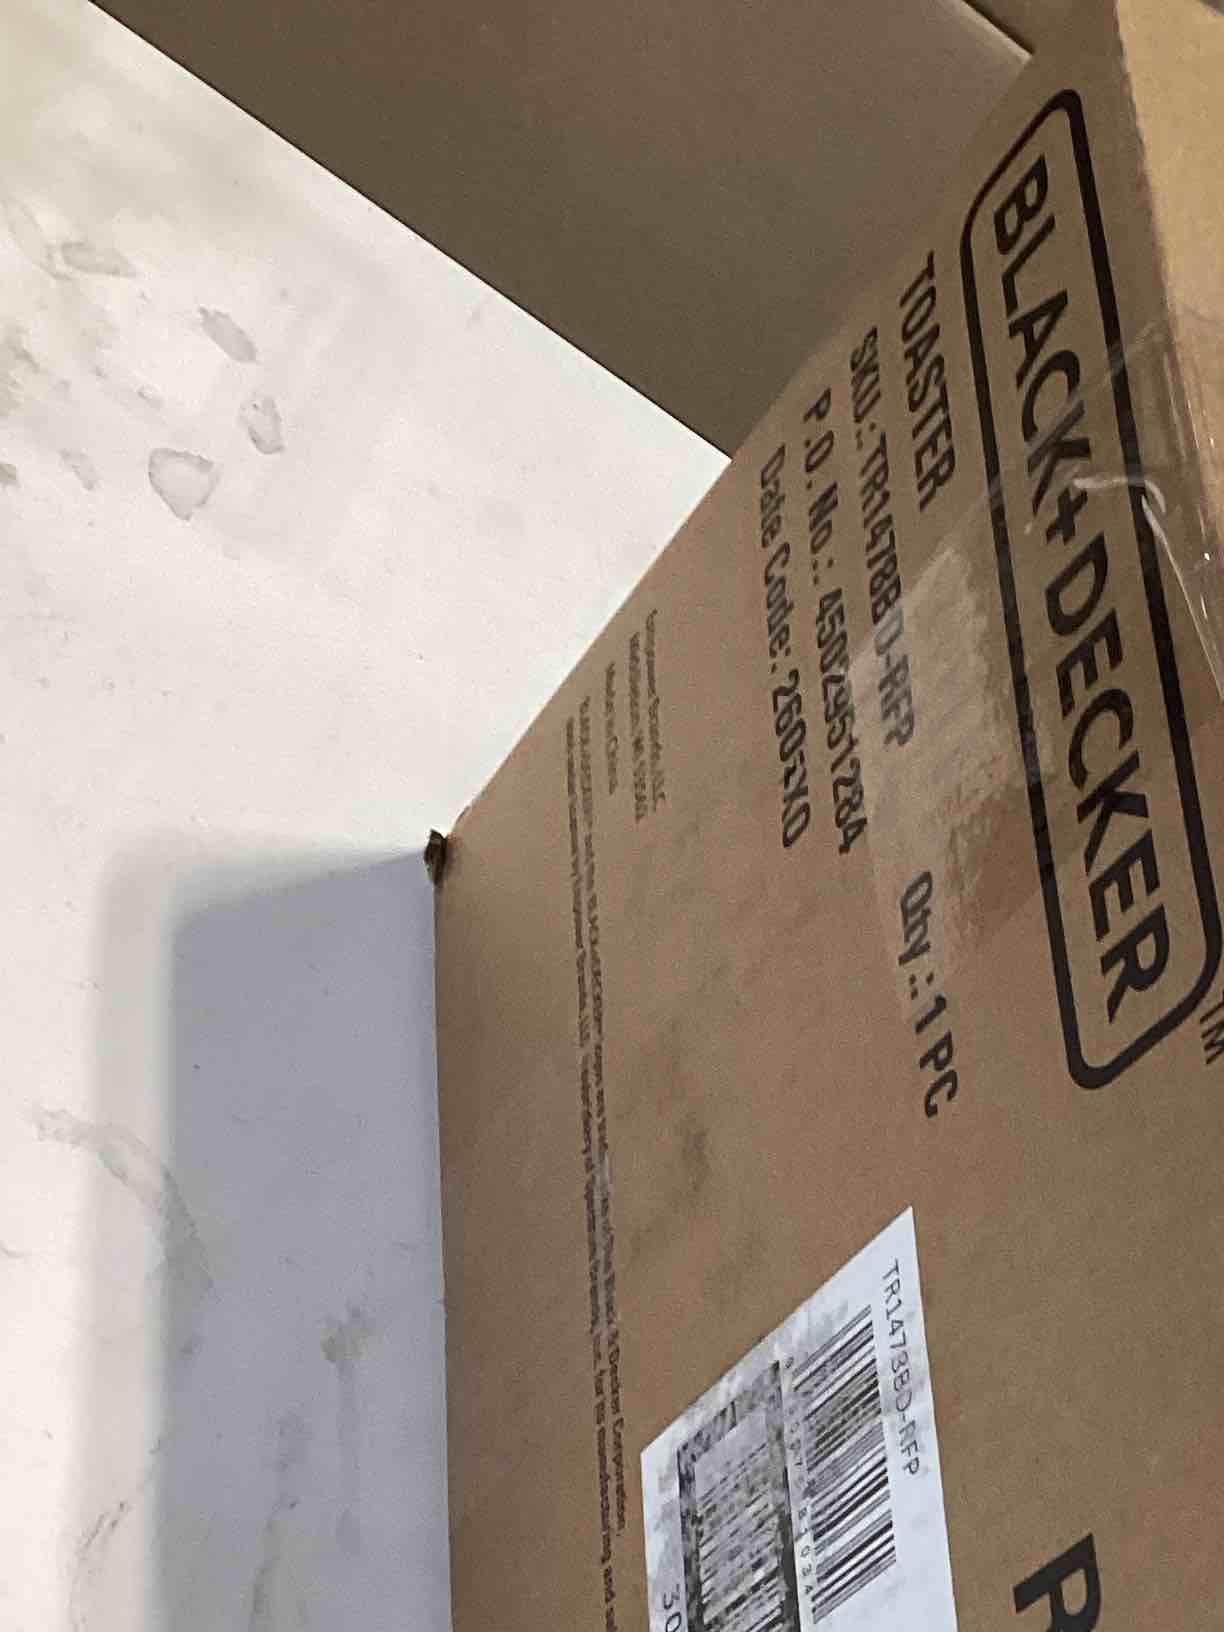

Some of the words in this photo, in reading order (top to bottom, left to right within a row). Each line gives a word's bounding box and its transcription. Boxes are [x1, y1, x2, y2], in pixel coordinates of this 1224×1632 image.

[899, 250, 957, 512] TOASTER
[760, 443, 787, 549] Date
[763, 541, 794, 675] Code:
[994, 154, 1171, 1024] BLACK+DECKER
[914, 994, 947, 1036] 1
[918, 1030, 959, 1119] PC
